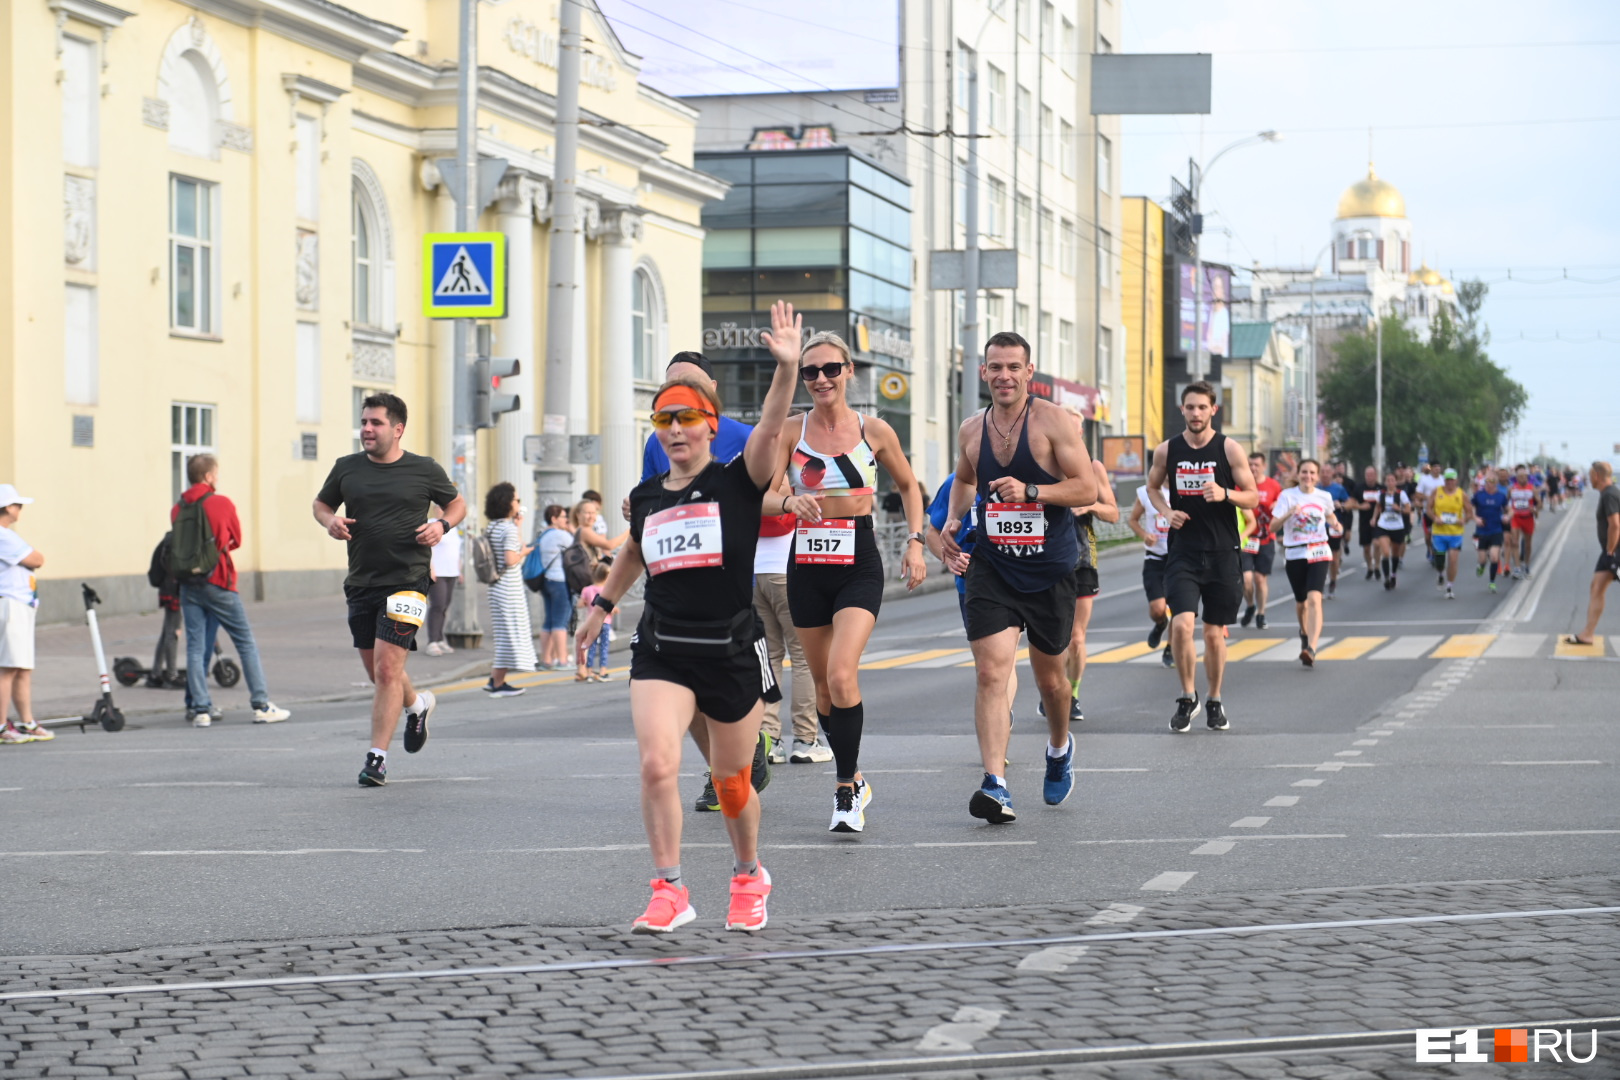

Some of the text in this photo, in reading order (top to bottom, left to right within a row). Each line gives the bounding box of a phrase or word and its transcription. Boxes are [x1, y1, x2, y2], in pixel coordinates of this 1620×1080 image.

[996, 521, 1033, 534] 1893
[656, 532, 702, 556] 1124
[806, 538, 841, 552] 1517
[394, 602, 423, 618] 5287
